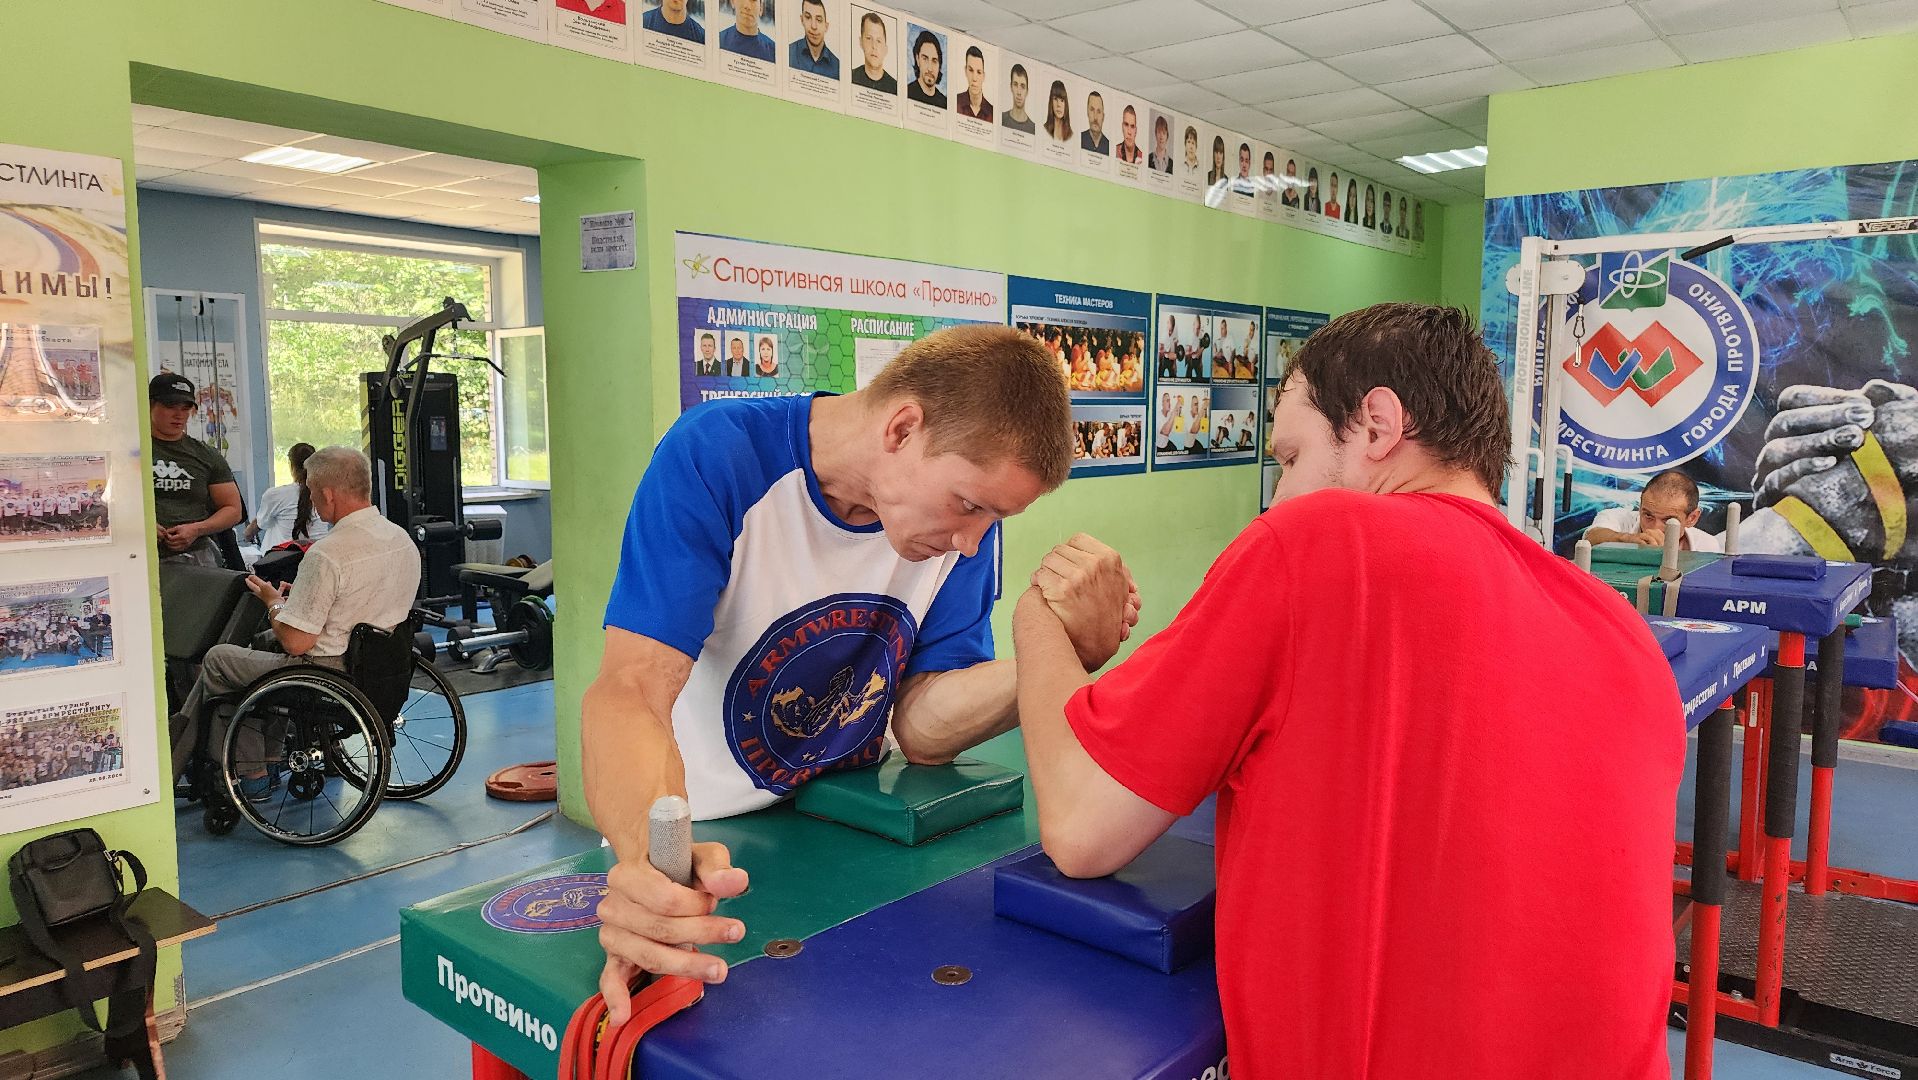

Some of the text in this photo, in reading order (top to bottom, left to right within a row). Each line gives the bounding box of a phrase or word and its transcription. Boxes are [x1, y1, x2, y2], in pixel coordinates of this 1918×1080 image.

[713, 257, 998, 307] Спортивная школа «Протвино»
[707, 306, 818, 331] АДМИНИСТРАЦИЯ
[1055, 293, 1114, 309] ТЕХНИКА МАСТЕРОВ
[850, 317, 915, 337] РАСПИСАНИЕ
[1517, 268, 1534, 394] PROFESSIONAL LINE
[1688, 283, 1744, 372] ПРОТВИНО
[1680, 384, 1740, 447] ГОРОДА
[154, 477, 191, 491] appa
[1722, 600, 1767, 615] АРМ
[437, 955, 558, 1051] Протвино
